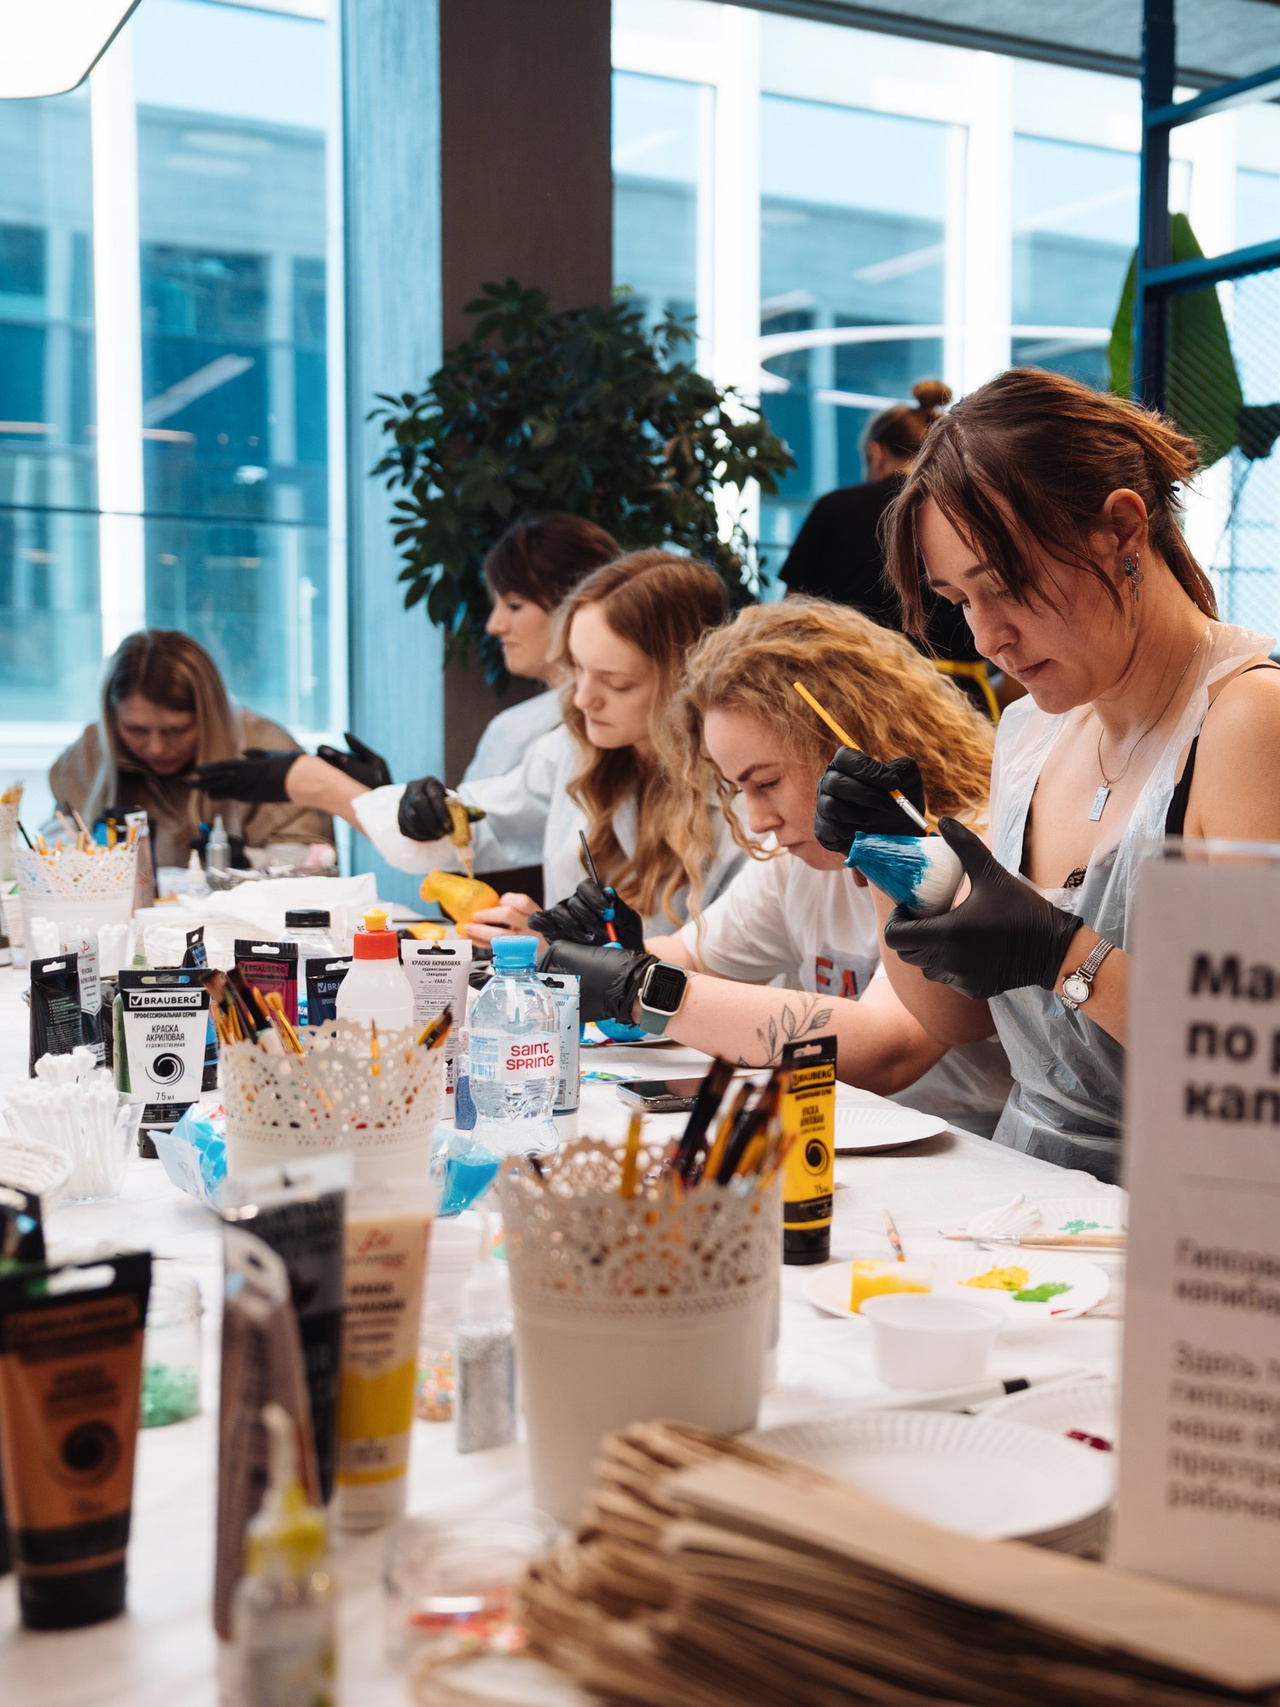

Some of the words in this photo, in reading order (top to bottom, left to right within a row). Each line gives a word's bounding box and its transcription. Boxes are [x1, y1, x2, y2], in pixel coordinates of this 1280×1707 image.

[144, 996, 197, 1005] BRAUBERG
[152, 1025, 179, 1033] КРАСКА
[146, 1033, 185, 1042] АКРИЛОВАЯ
[1185, 1020, 1255, 1063] по
[506, 1055, 554, 1070] SPRING
[155, 1092, 167, 1101] 75
